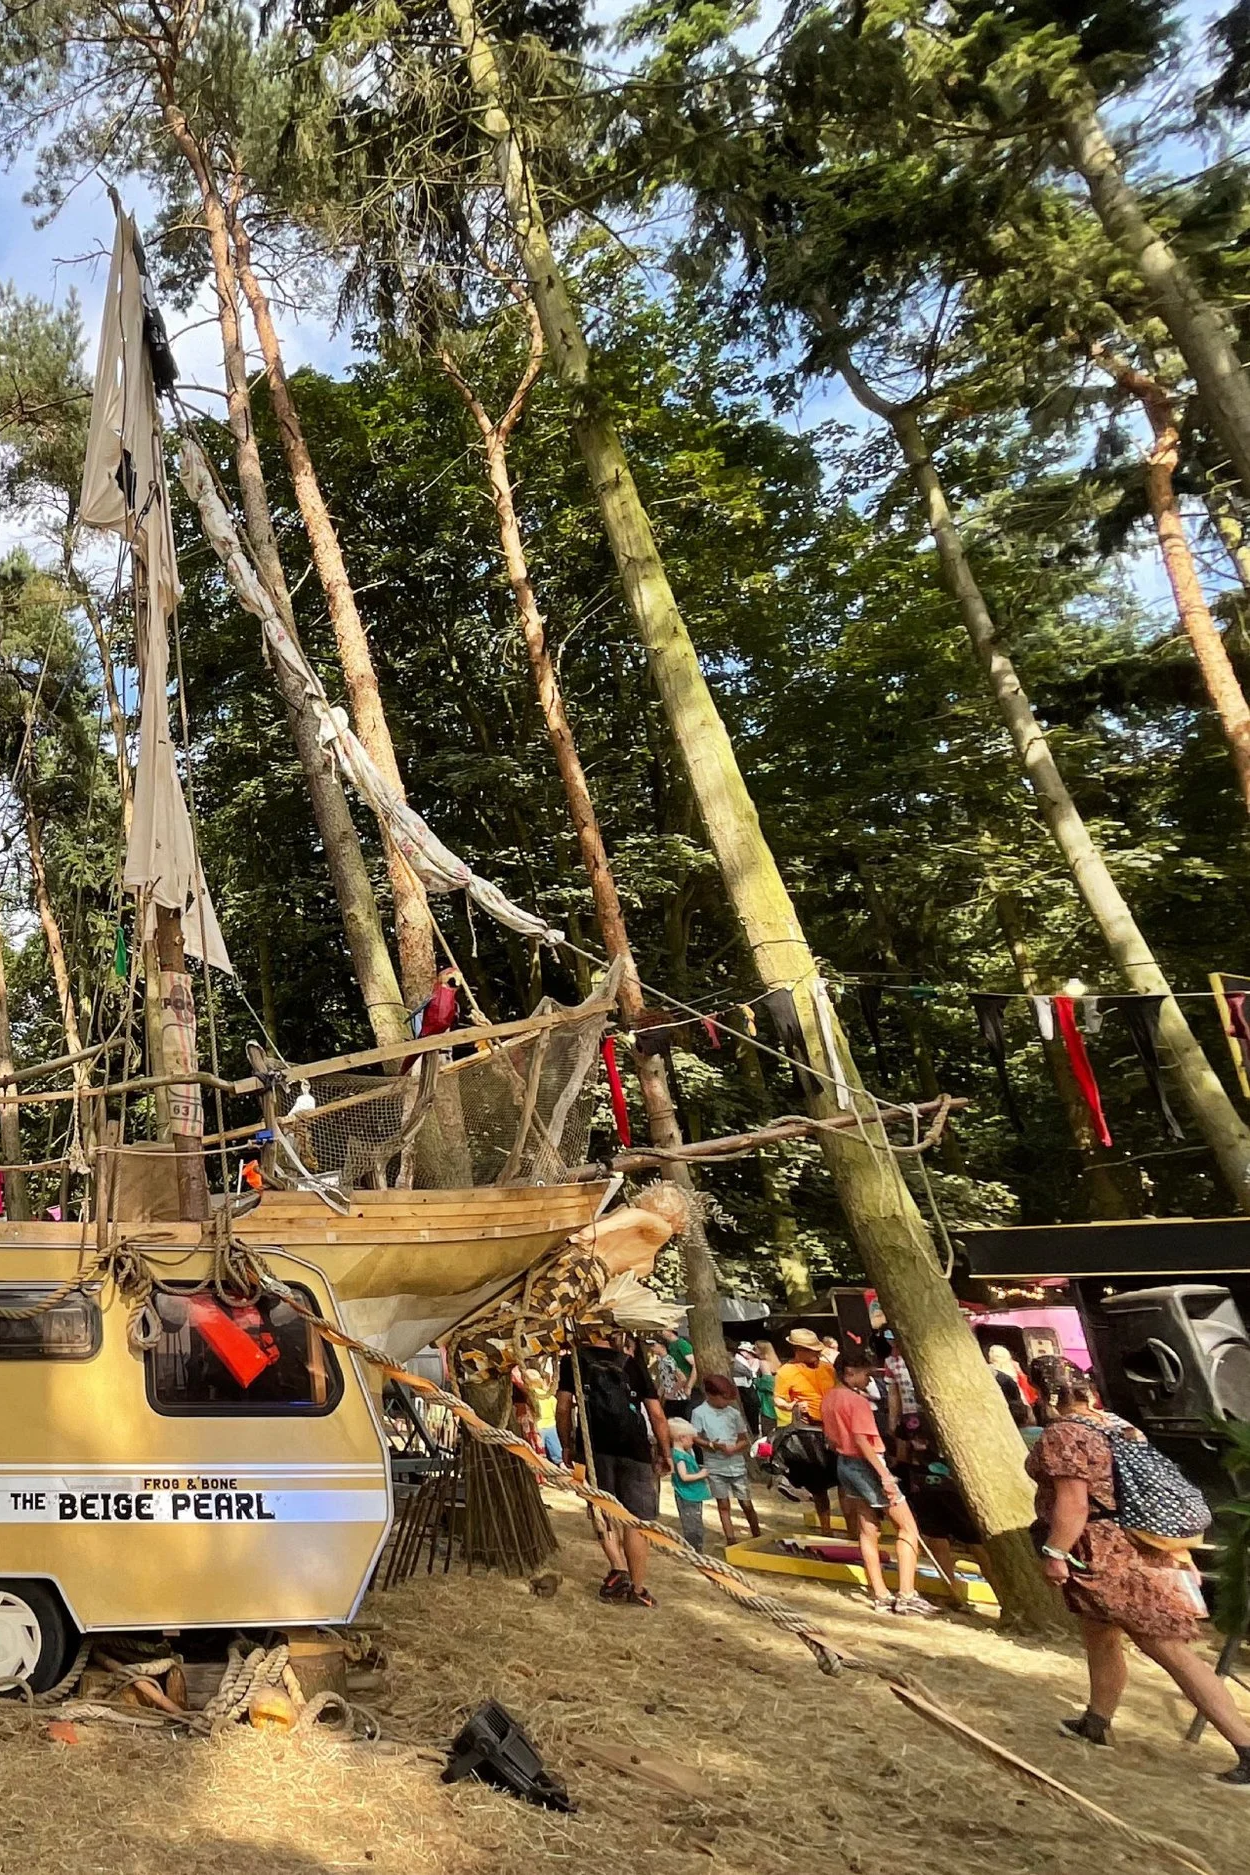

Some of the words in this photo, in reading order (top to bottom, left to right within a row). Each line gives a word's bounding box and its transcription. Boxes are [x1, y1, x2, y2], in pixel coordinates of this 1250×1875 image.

[173, 1104, 190, 1116] 63
[143, 1478, 180, 1490] FROG
[187, 1478, 197, 1490] &
[201, 1478, 238, 1490] BONE
[10, 1493, 46, 1511] THE
[58, 1492, 154, 1520] BEIGE
[171, 1492, 276, 1520] PEARL
